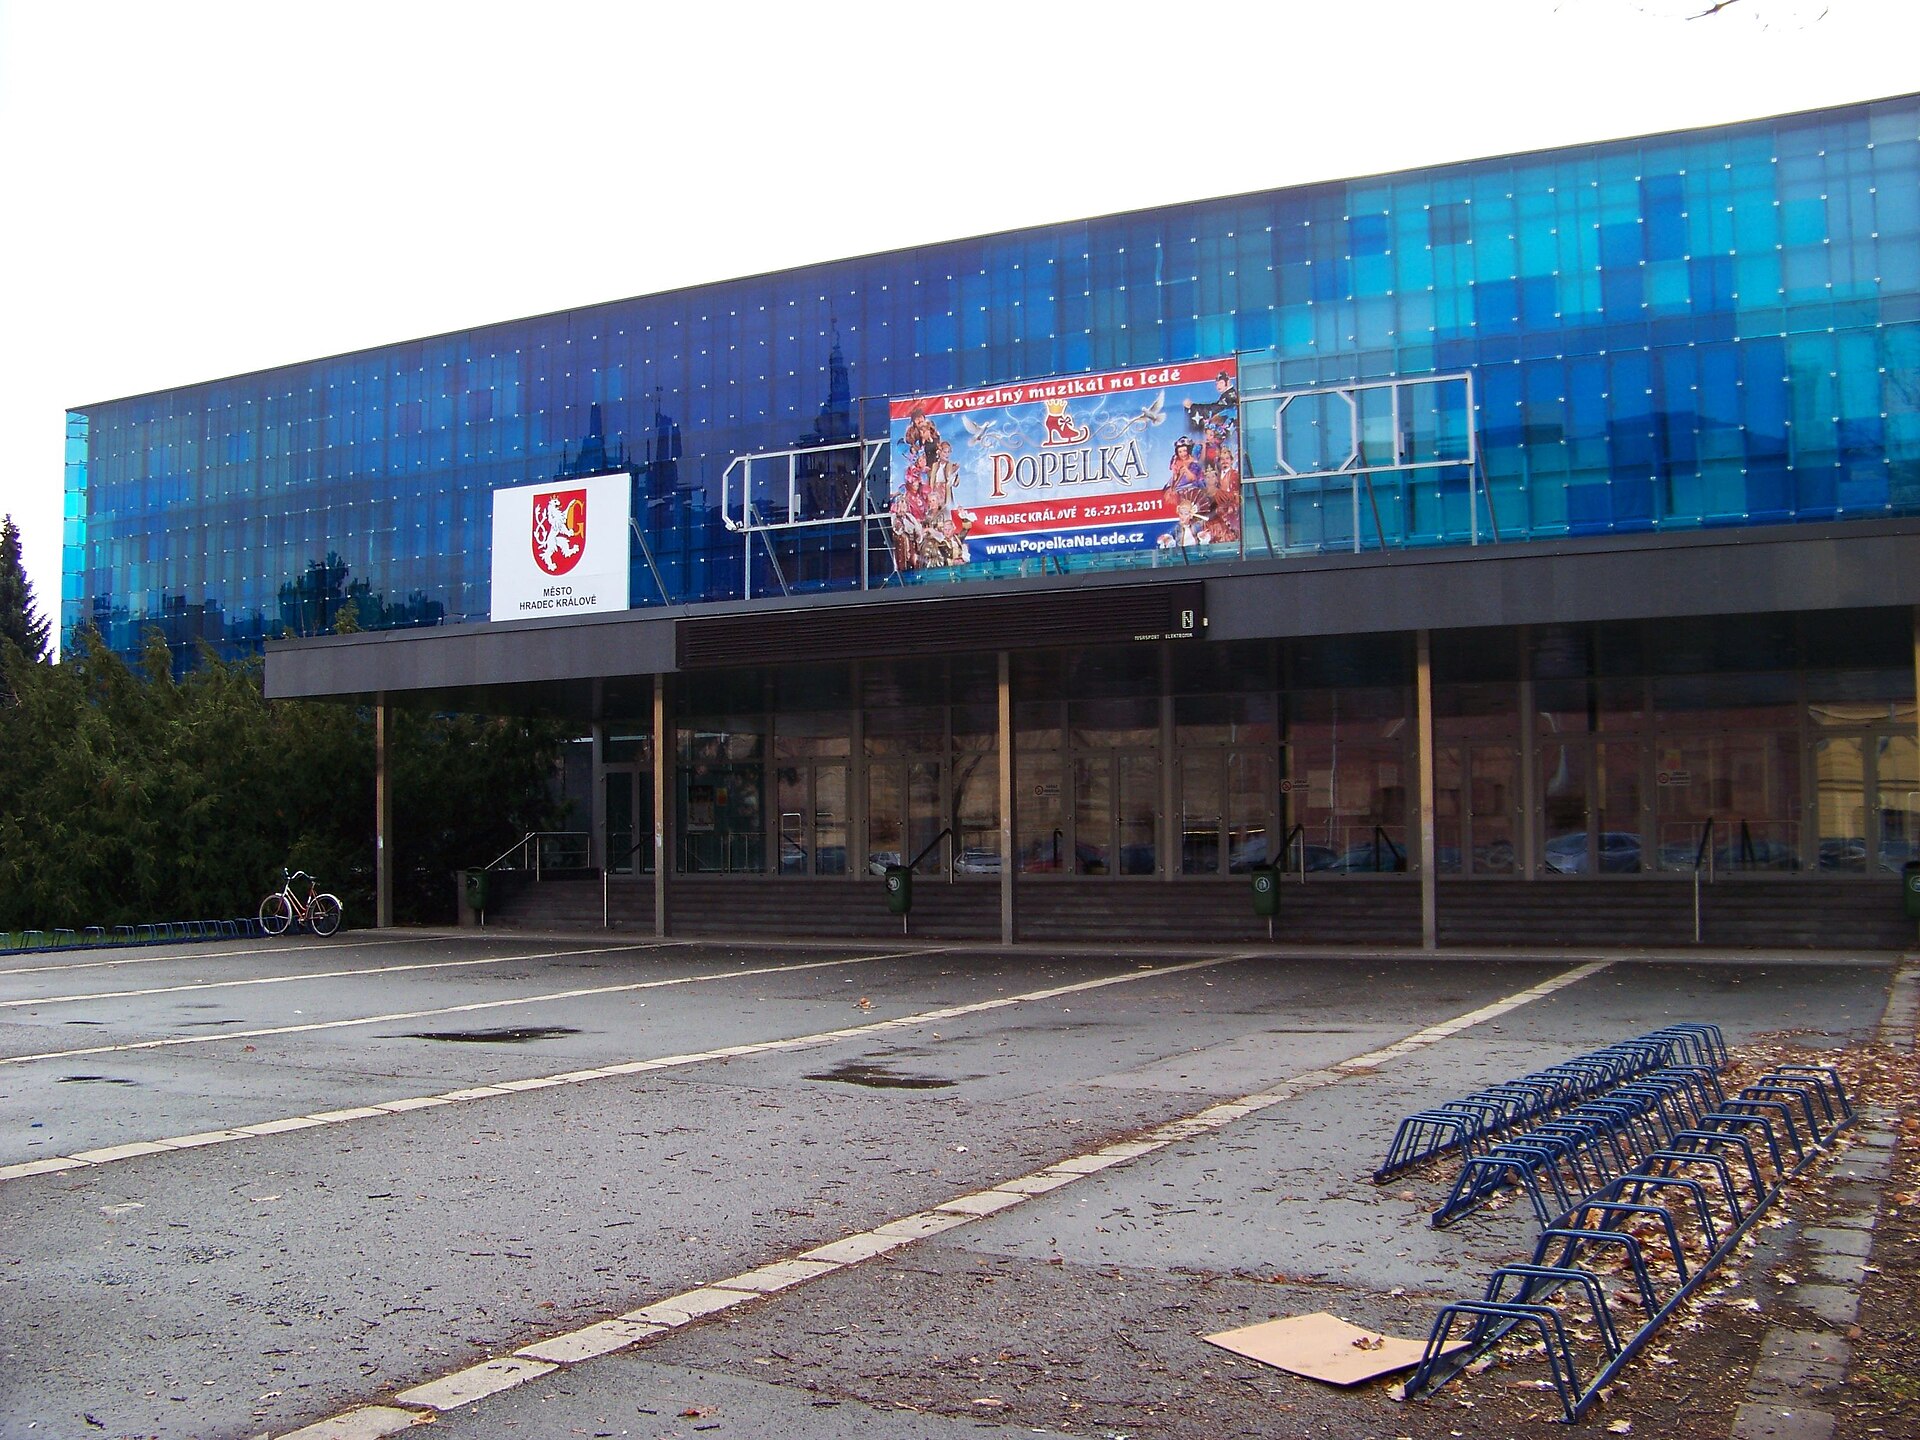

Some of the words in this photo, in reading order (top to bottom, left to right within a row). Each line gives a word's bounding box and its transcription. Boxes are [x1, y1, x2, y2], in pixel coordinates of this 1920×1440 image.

[944, 388, 1023, 409] kouzelný
[1028, 377, 1103, 399] muzikál
[1110, 375, 1134, 388] na
[1140, 368, 1182, 385] ledě
[991, 441, 1147, 498] POPELKA
[984, 512, 1027, 525] HRADEC
[1028, 505, 1077, 522] KRÁLOVÉ
[1083, 499, 1163, 518] 26.-27.12.2011
[985, 532, 1145, 555] www.PopelkaNaLede.cz
[519, 599, 554, 611] HRADEC
[556, 594, 597, 608] KRÁLOVÉ
[543, 586, 573, 597] MĚSTO
